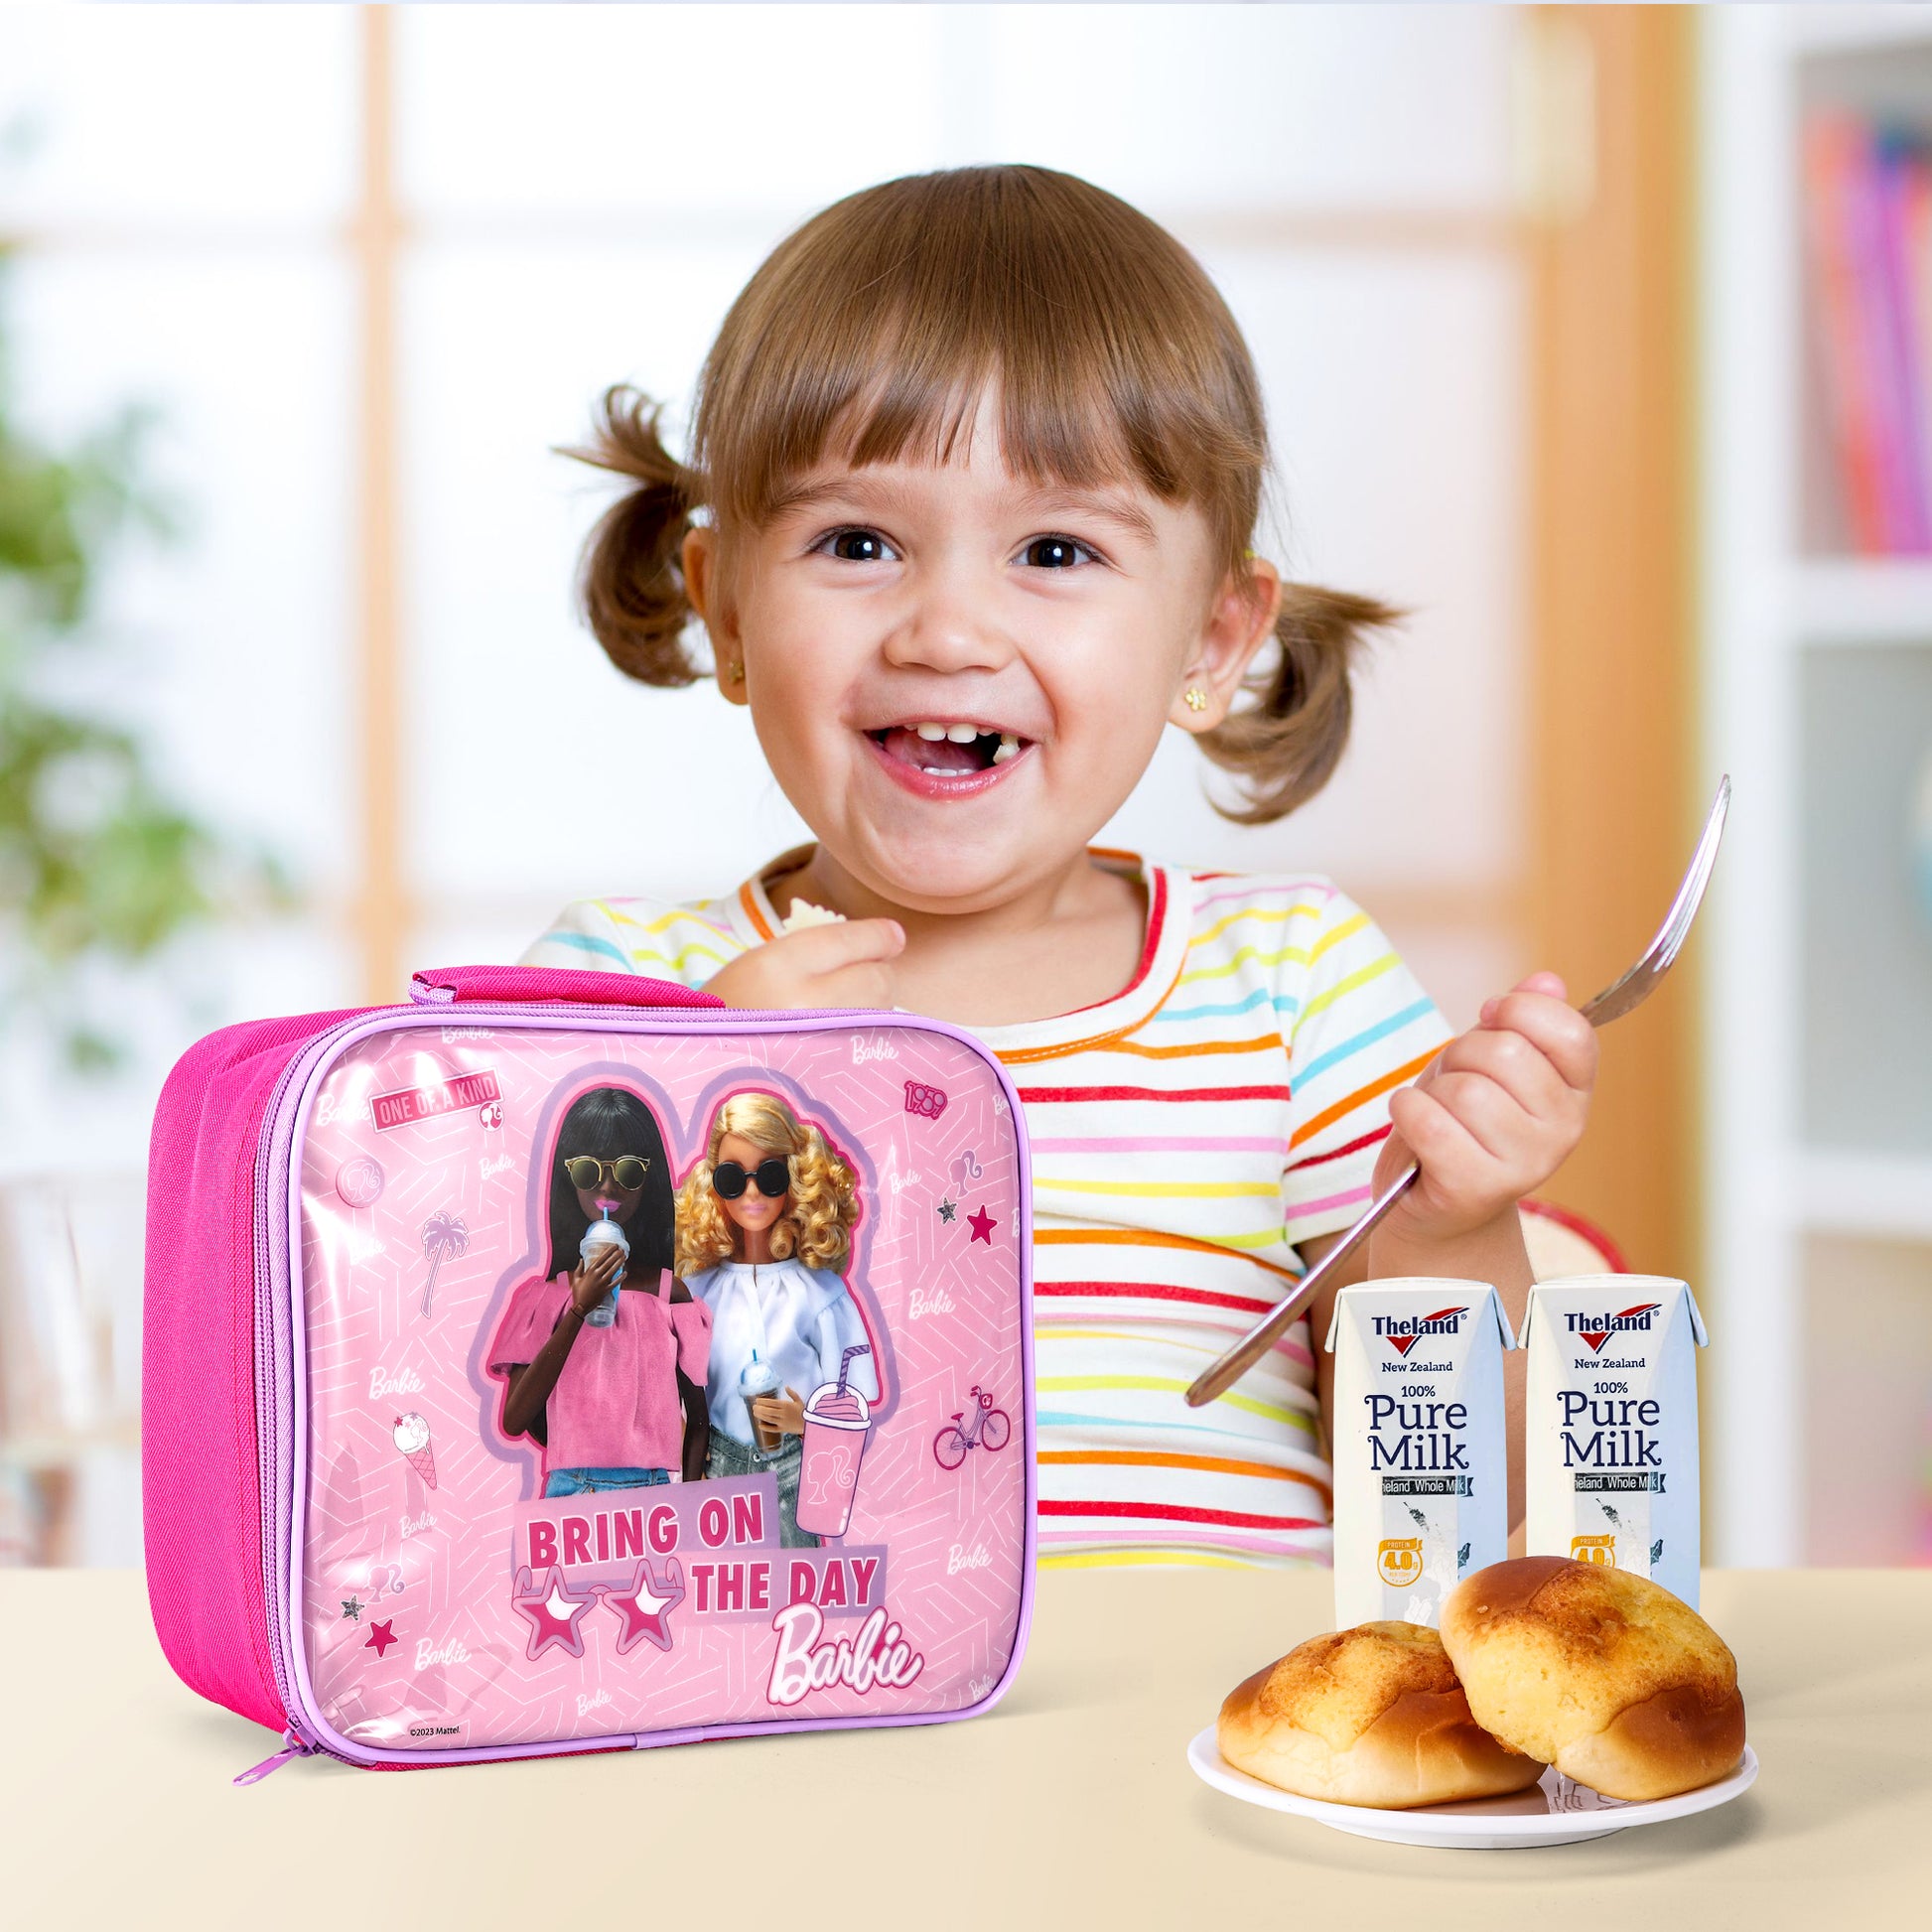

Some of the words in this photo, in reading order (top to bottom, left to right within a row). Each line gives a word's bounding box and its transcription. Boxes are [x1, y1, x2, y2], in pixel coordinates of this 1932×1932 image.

[851, 1035, 898, 1064] Barbie
[316, 1093, 370, 1126] Barie
[379, 1096, 413, 1124] ONE
[457, 1075, 496, 1105] KIND
[479, 1155, 515, 1179] Barbie
[890, 1170, 921, 1193] Barbie
[908, 1290, 956, 1319] Barbie
[1371, 1314, 1458, 1335] Theland
[1564, 1311, 1651, 1331] Theland
[1381, 1362, 1407, 1372] New
[1409, 1361, 1453, 1372] Zealand
[1574, 1358, 1600, 1369] New
[1602, 1357, 1646, 1368] Zealand
[368, 1366, 425, 1400] Barbie
[1401, 1385, 1436, 1397] 100%
[1593, 1381, 1628, 1394] 100%
[1364, 1394, 1467, 1431] Pure
[1557, 1390, 1660, 1427] Pure
[1367, 1434, 1469, 1470] Milk
[1560, 1430, 1662, 1467] Milk
[1415, 1479, 1444, 1492] Whole
[1607, 1475, 1636, 1489] Whole
[399, 1514, 437, 1538] Barbie
[528, 1505, 678, 1570] BRING
[699, 1493, 763, 1549] ON
[947, 1543, 993, 1576] Barbie
[691, 1562, 771, 1613] THE
[789, 1557, 879, 1608] DAY
[414, 1638, 473, 1671] Barbie
[766, 1600, 924, 1706] Barbie
[576, 1690, 612, 1717] Barbie
[410, 1727, 435, 1736] ©2023
